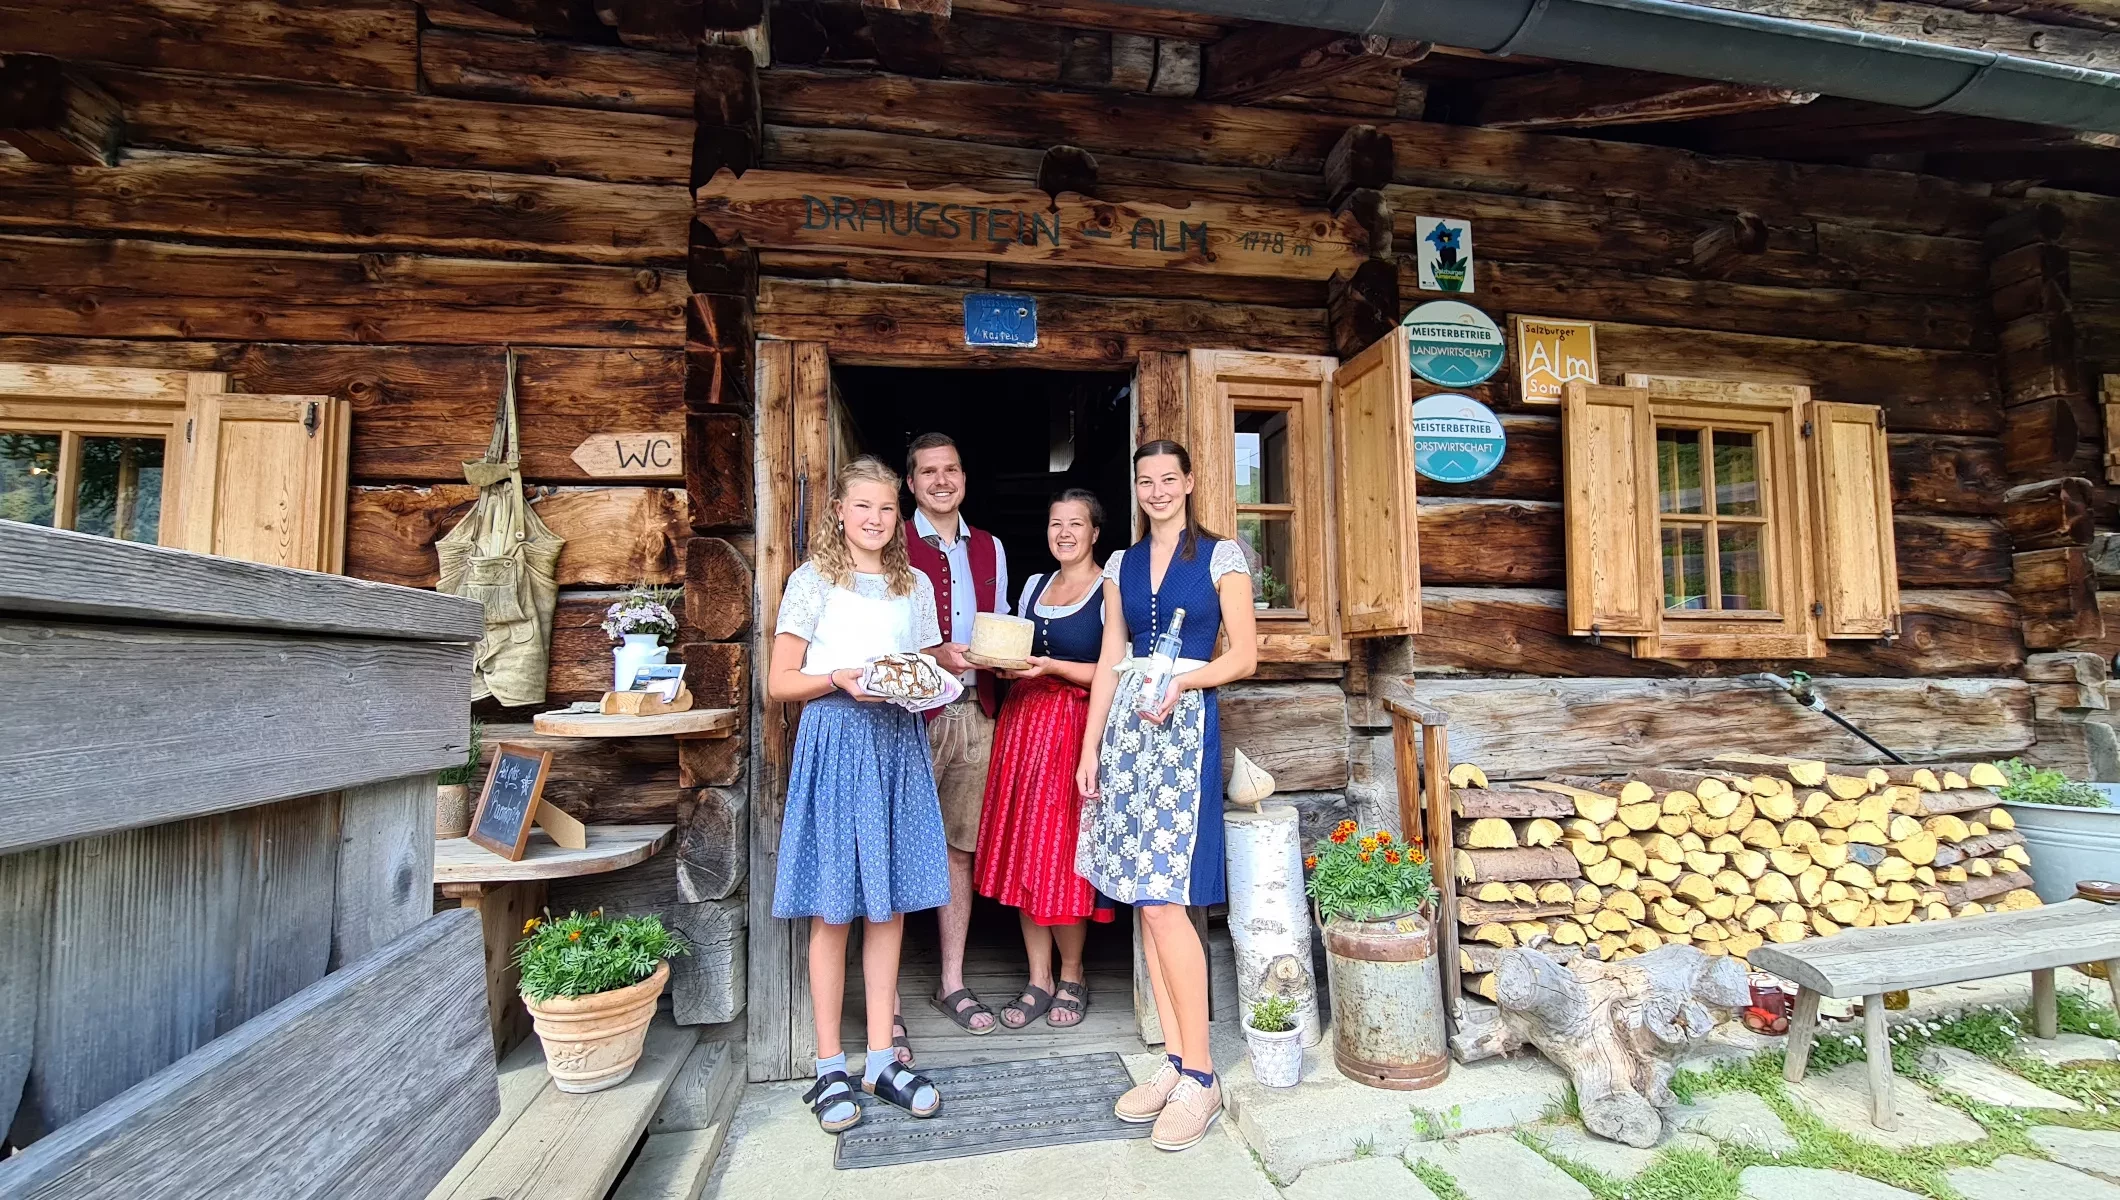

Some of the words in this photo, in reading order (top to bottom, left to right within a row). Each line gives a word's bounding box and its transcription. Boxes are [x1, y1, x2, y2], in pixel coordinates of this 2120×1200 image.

[802, 194, 1060, 247] DRAUGSTEIN
[1129, 217, 1208, 256] ALM
[1237, 231, 1284, 254] 1778
[1293, 244, 1312, 257] m
[1412, 327, 1491, 340] MEISTERBETRIEB
[1525, 324, 1575, 341] Salzburger
[1412, 345, 1492, 358] LANDWIRTSCHAFT
[1528, 339, 1590, 379] Alm
[1530, 379, 1561, 395] Som
[1413, 423, 1492, 434] MEISTERBETRIEB
[615, 439, 672, 468] WC
[1414, 441, 1493, 453] ORSTWIRTSCHAFT
